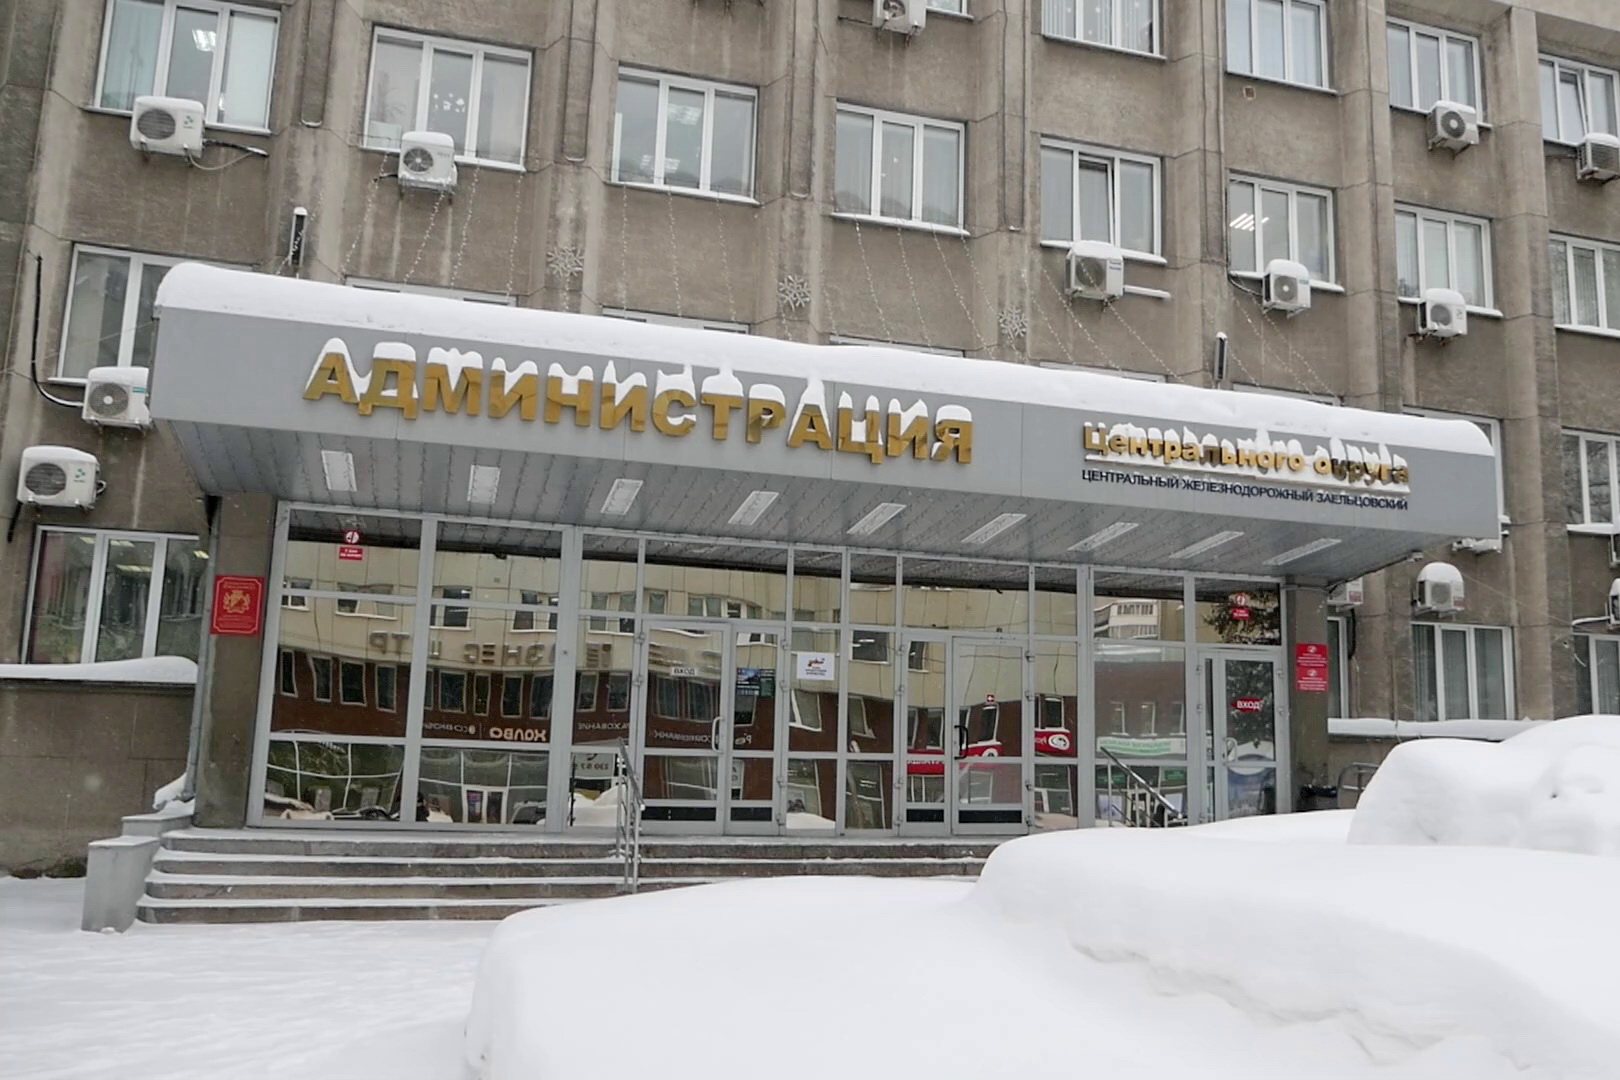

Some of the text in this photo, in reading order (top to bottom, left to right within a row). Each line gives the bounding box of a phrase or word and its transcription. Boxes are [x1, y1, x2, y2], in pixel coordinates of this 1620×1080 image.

[302, 345, 972, 463] АДМИНИСТРАЦИЯ
[1083, 424, 1306, 473] Центрального
[1082, 469, 1408, 510] ЦЕНТРАЛЬНЫЙ ЖЕЛЕЗНОДОРОЖНЫЙ ЗАЕЛЬЦОВСКИЙ
[1237, 700, 1260, 711] ВХОД
